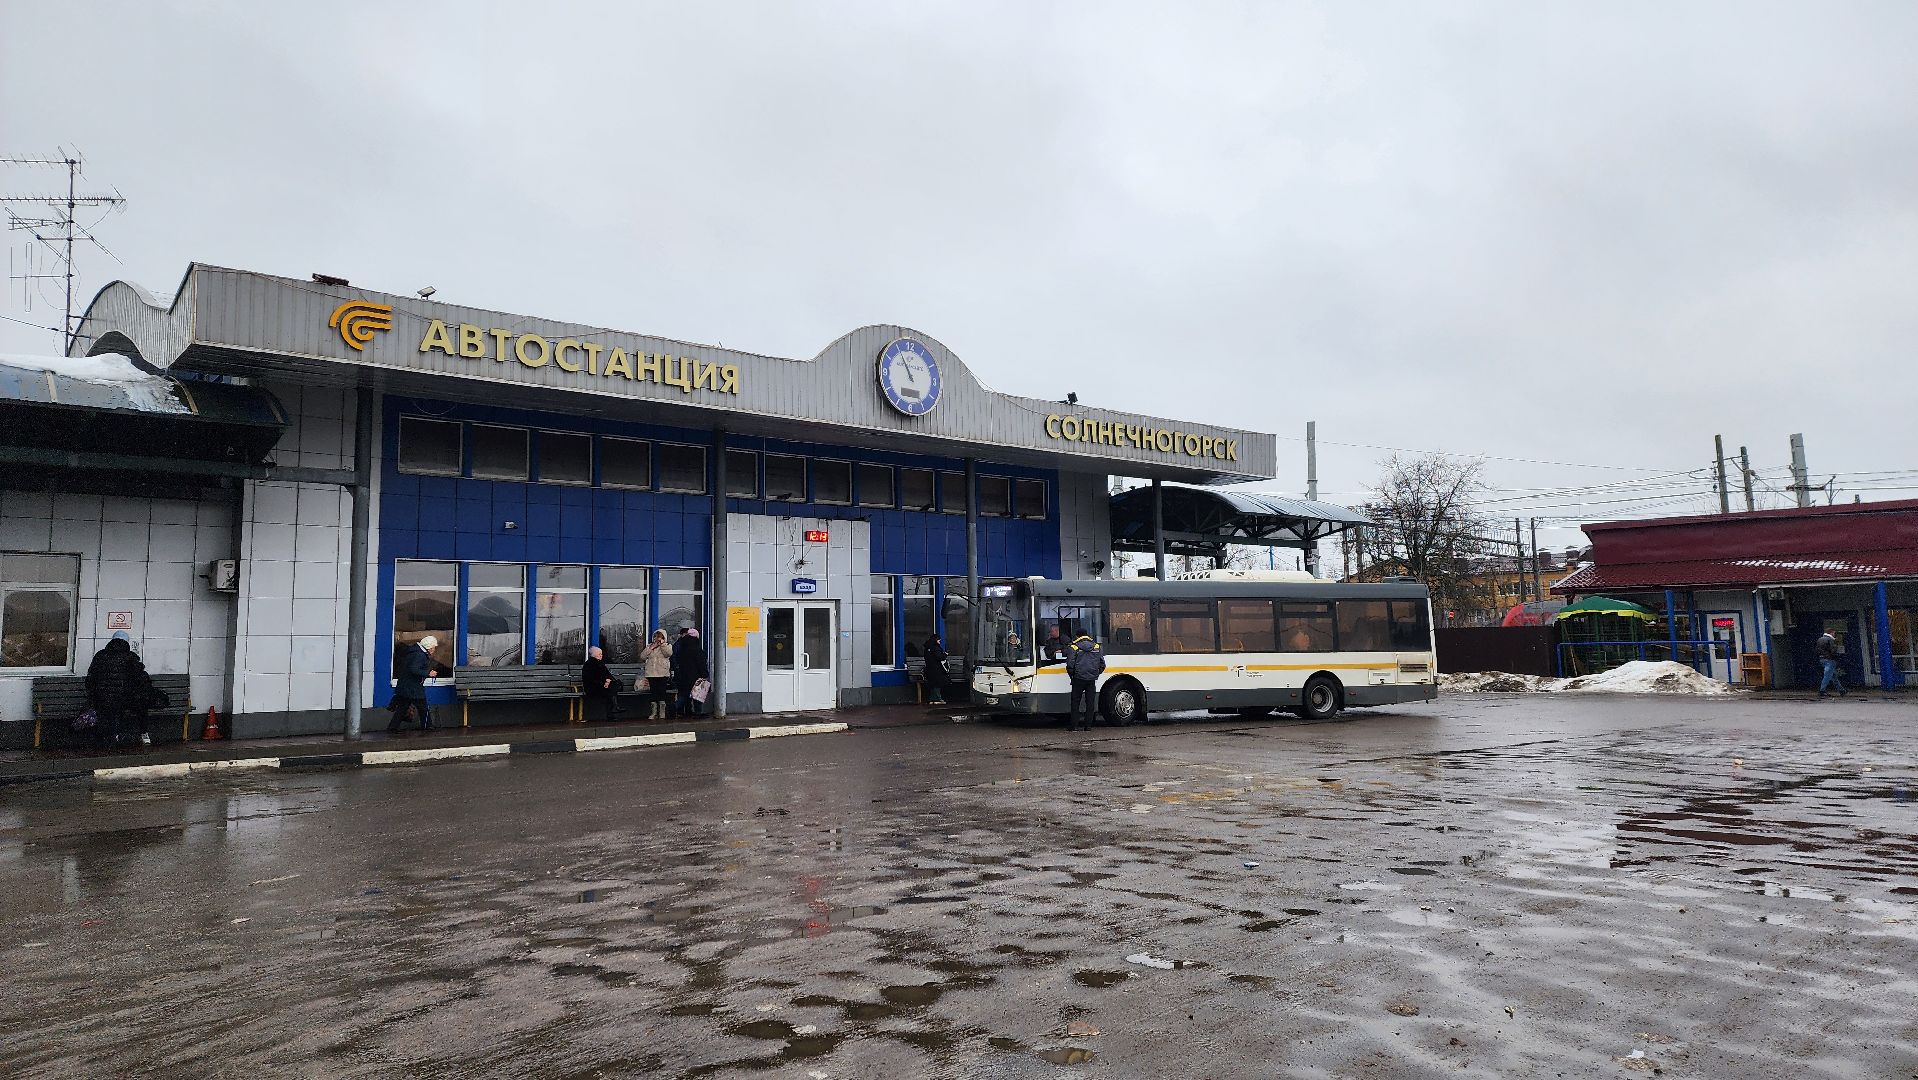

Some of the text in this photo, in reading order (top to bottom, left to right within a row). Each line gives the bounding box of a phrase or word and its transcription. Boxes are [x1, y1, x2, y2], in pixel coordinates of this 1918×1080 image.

[906, 342, 914, 351] 12
[419, 319, 740, 394] АВТОСТАНЦИЯ
[883, 368, 888, 376] 9
[932, 377, 937, 387] 3
[908, 403, 913, 412] 6
[1045, 414, 1238, 461] СОЛНЕЧНОГОРСК
